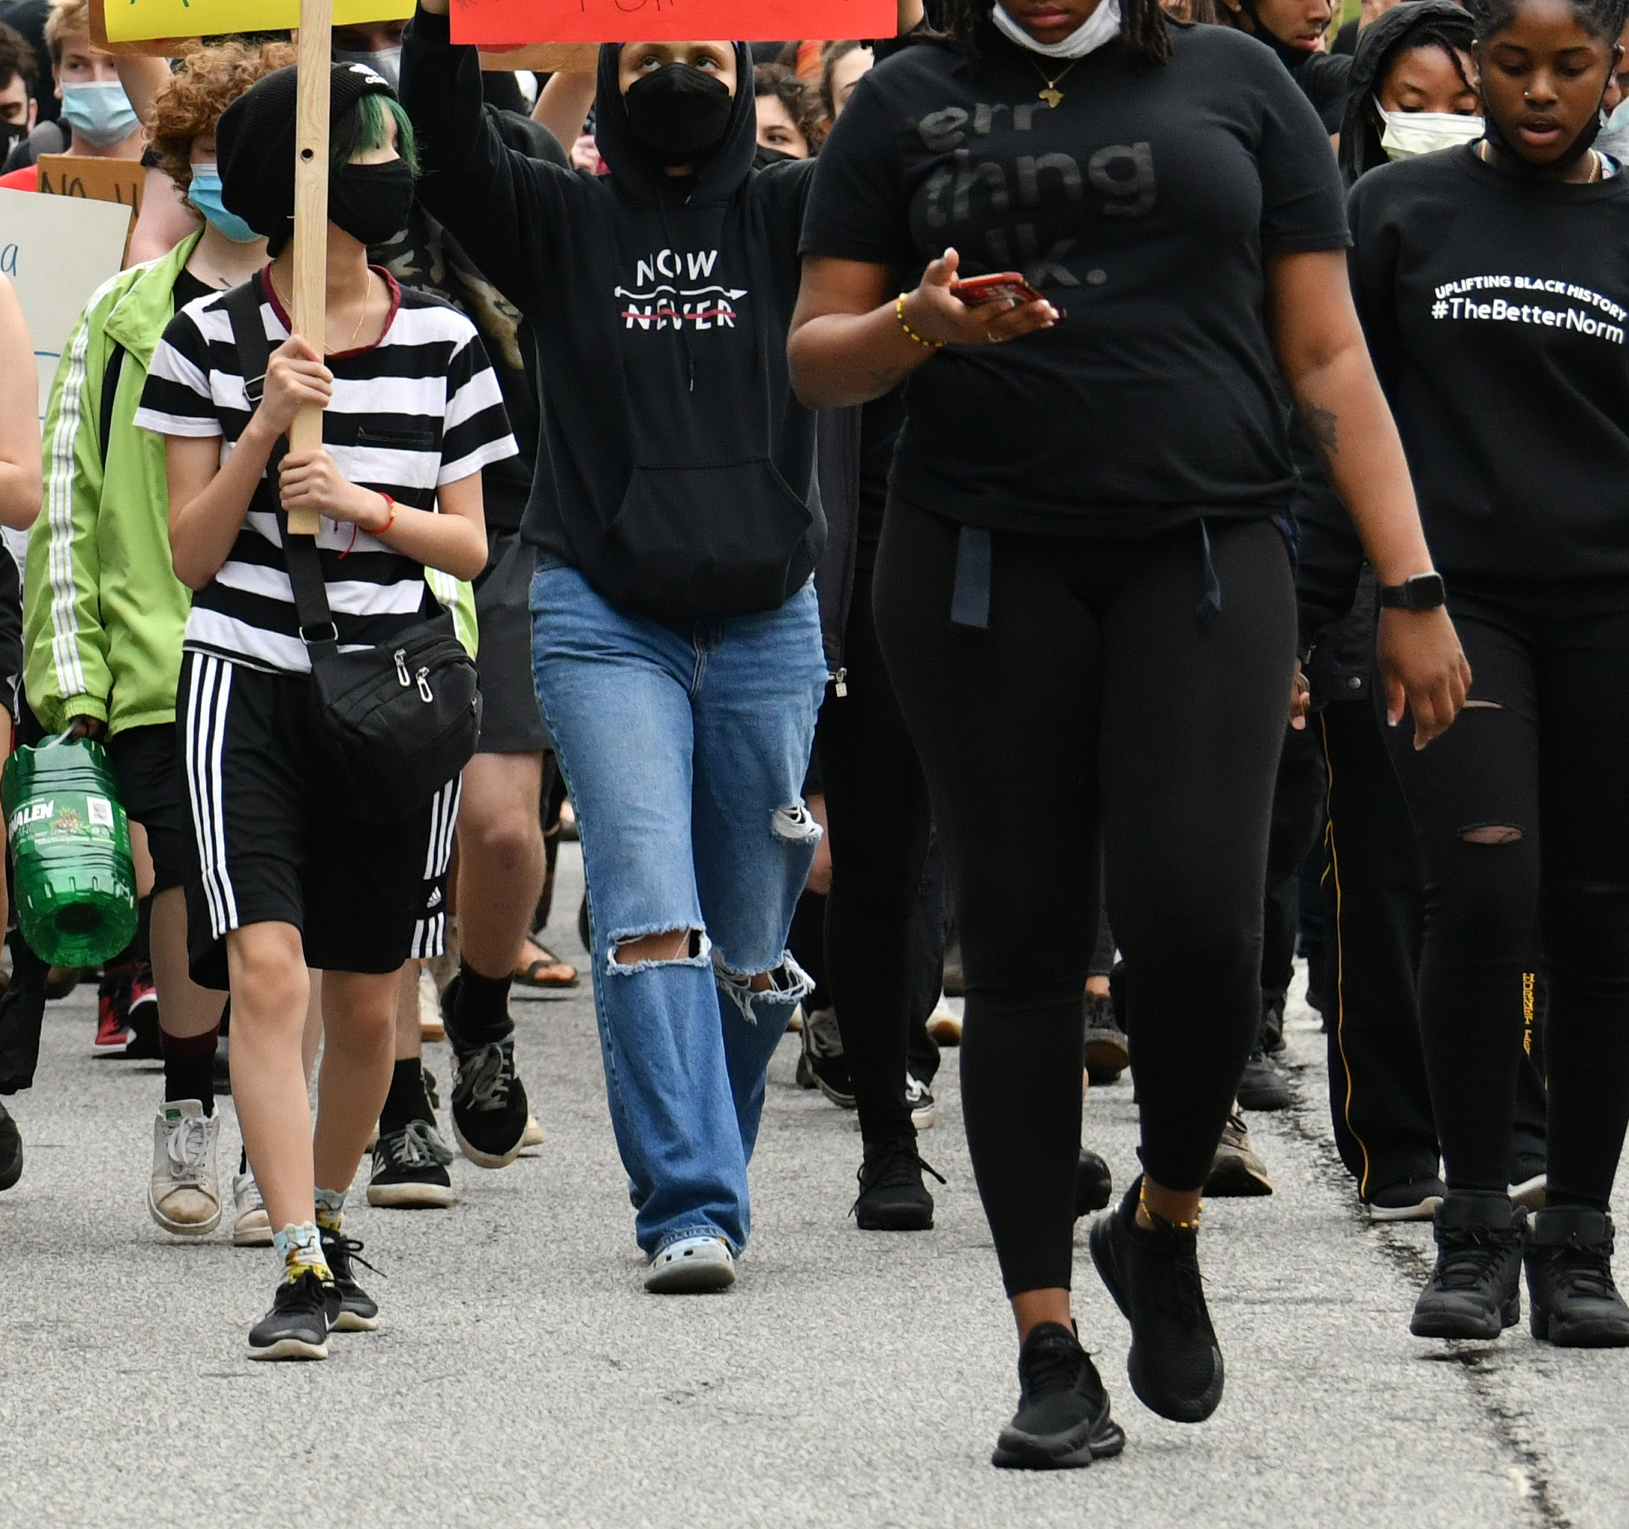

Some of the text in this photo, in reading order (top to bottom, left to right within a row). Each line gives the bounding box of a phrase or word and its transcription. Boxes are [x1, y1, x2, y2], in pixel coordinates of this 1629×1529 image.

[636, 248, 718, 286] NOW
[624, 298, 735, 332] NEVER
[1434, 275, 1628, 322] UPLIFTING BLACK HISTORY
[1430, 297, 1625, 345] #TheBetterNorm
